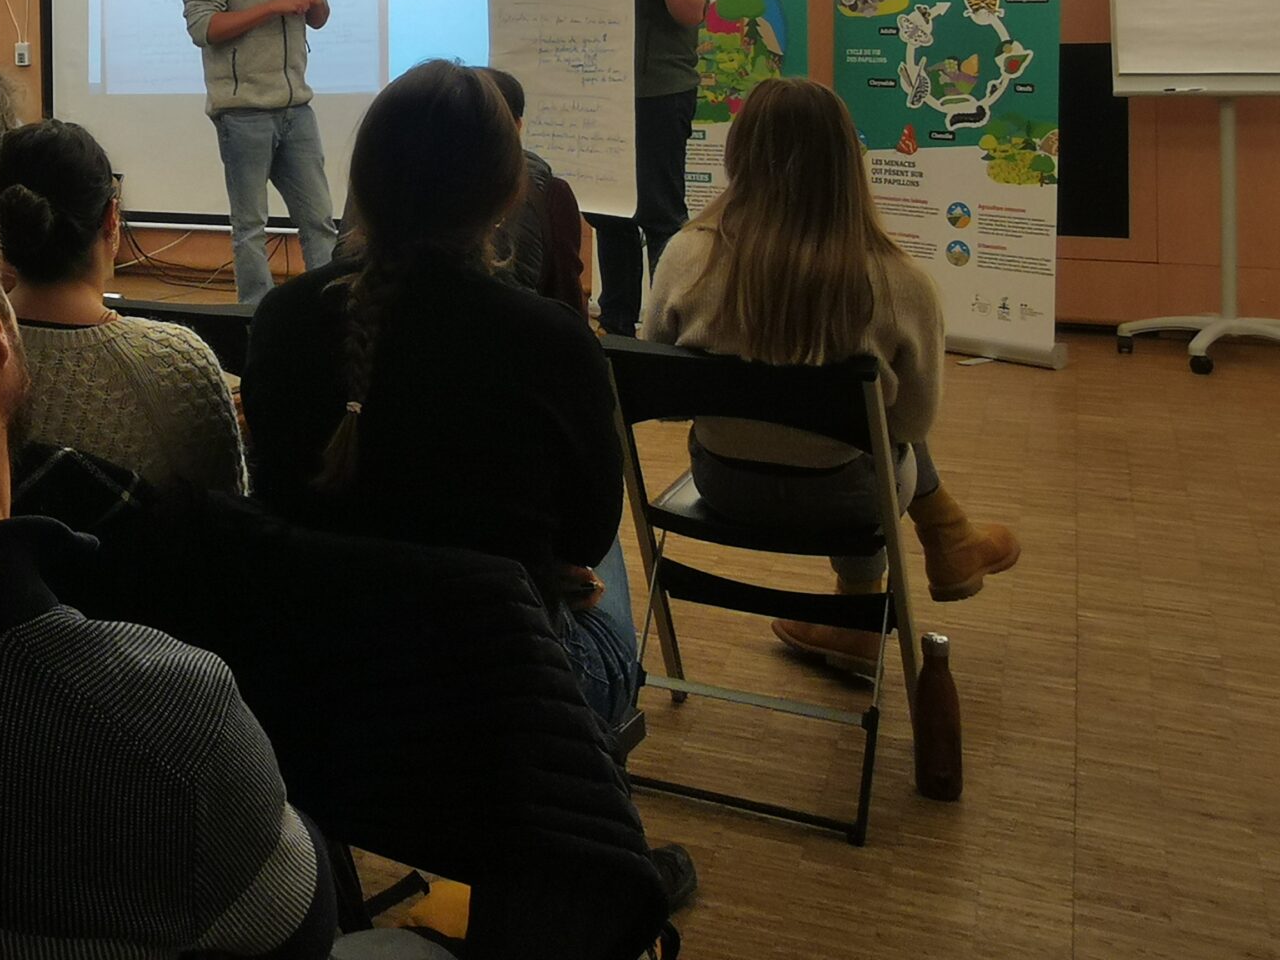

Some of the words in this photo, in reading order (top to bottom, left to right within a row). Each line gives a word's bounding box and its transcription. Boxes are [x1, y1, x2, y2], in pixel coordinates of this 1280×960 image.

[871, 158, 883, 166] LES
[883, 159, 916, 168] MENACES
[883, 178, 920, 187] PAPILLONS
